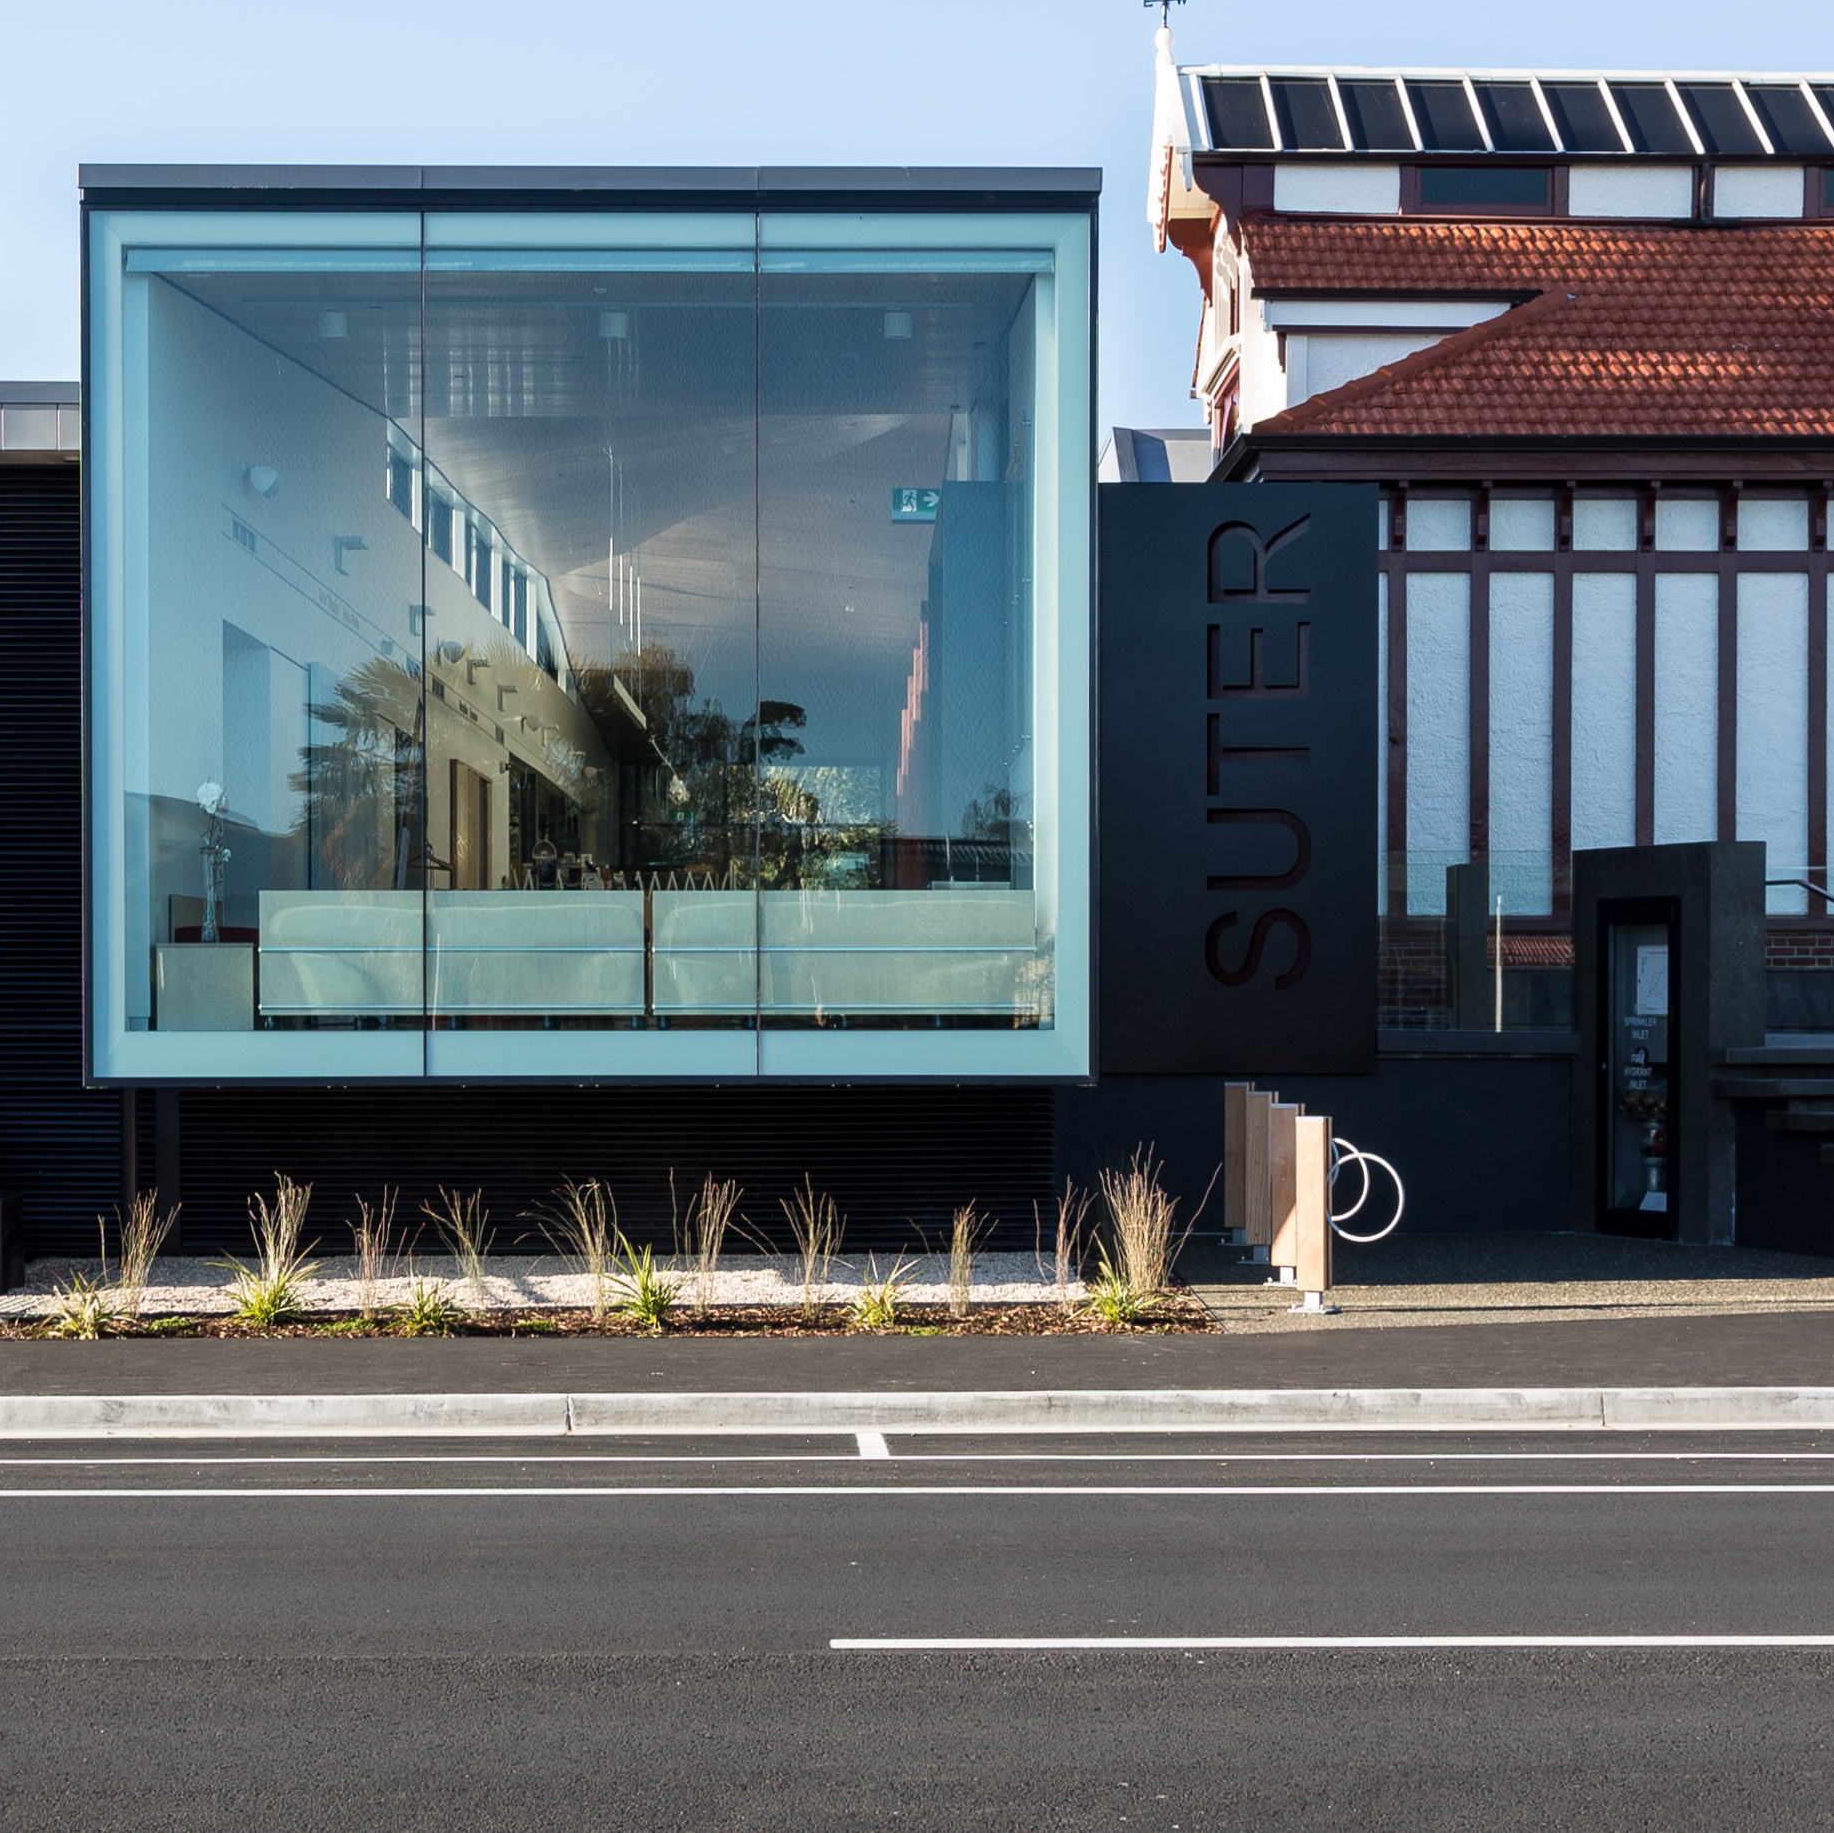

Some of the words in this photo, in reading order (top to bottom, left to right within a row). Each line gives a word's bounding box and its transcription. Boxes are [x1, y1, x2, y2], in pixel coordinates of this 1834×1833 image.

[1204, 512, 1312, 991] SUTER
[1631, 1029, 1649, 1040] INLET
[1623, 1067, 1652, 1077] HYDRANT
[1629, 1079, 1647, 1090] INLET
